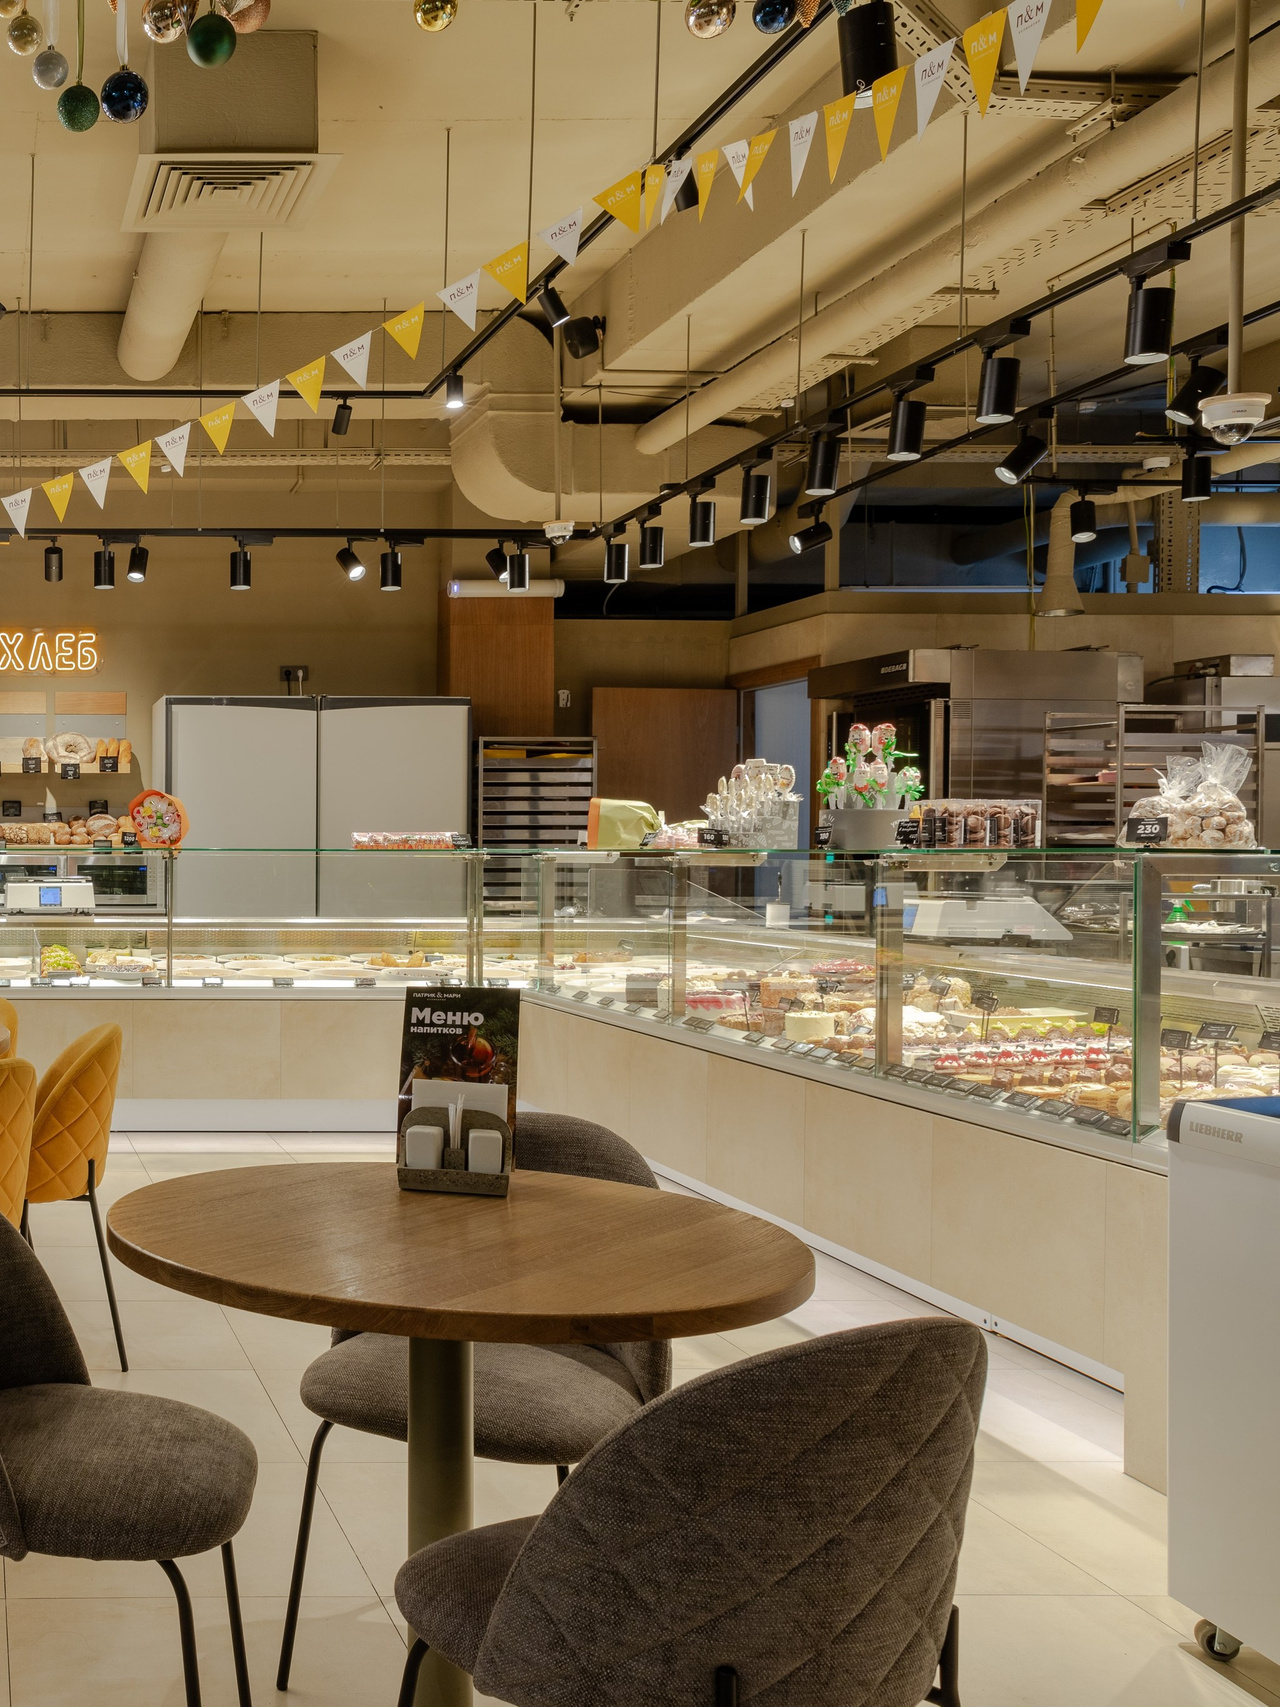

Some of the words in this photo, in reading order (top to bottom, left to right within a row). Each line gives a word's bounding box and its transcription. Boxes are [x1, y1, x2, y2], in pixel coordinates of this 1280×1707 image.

[1136, 824, 1160, 834] 230
[410, 1007, 485, 1026] Меню
[410, 1026, 463, 1034] напитков
[1189, 1120, 1244, 1144] LIEBHERR
